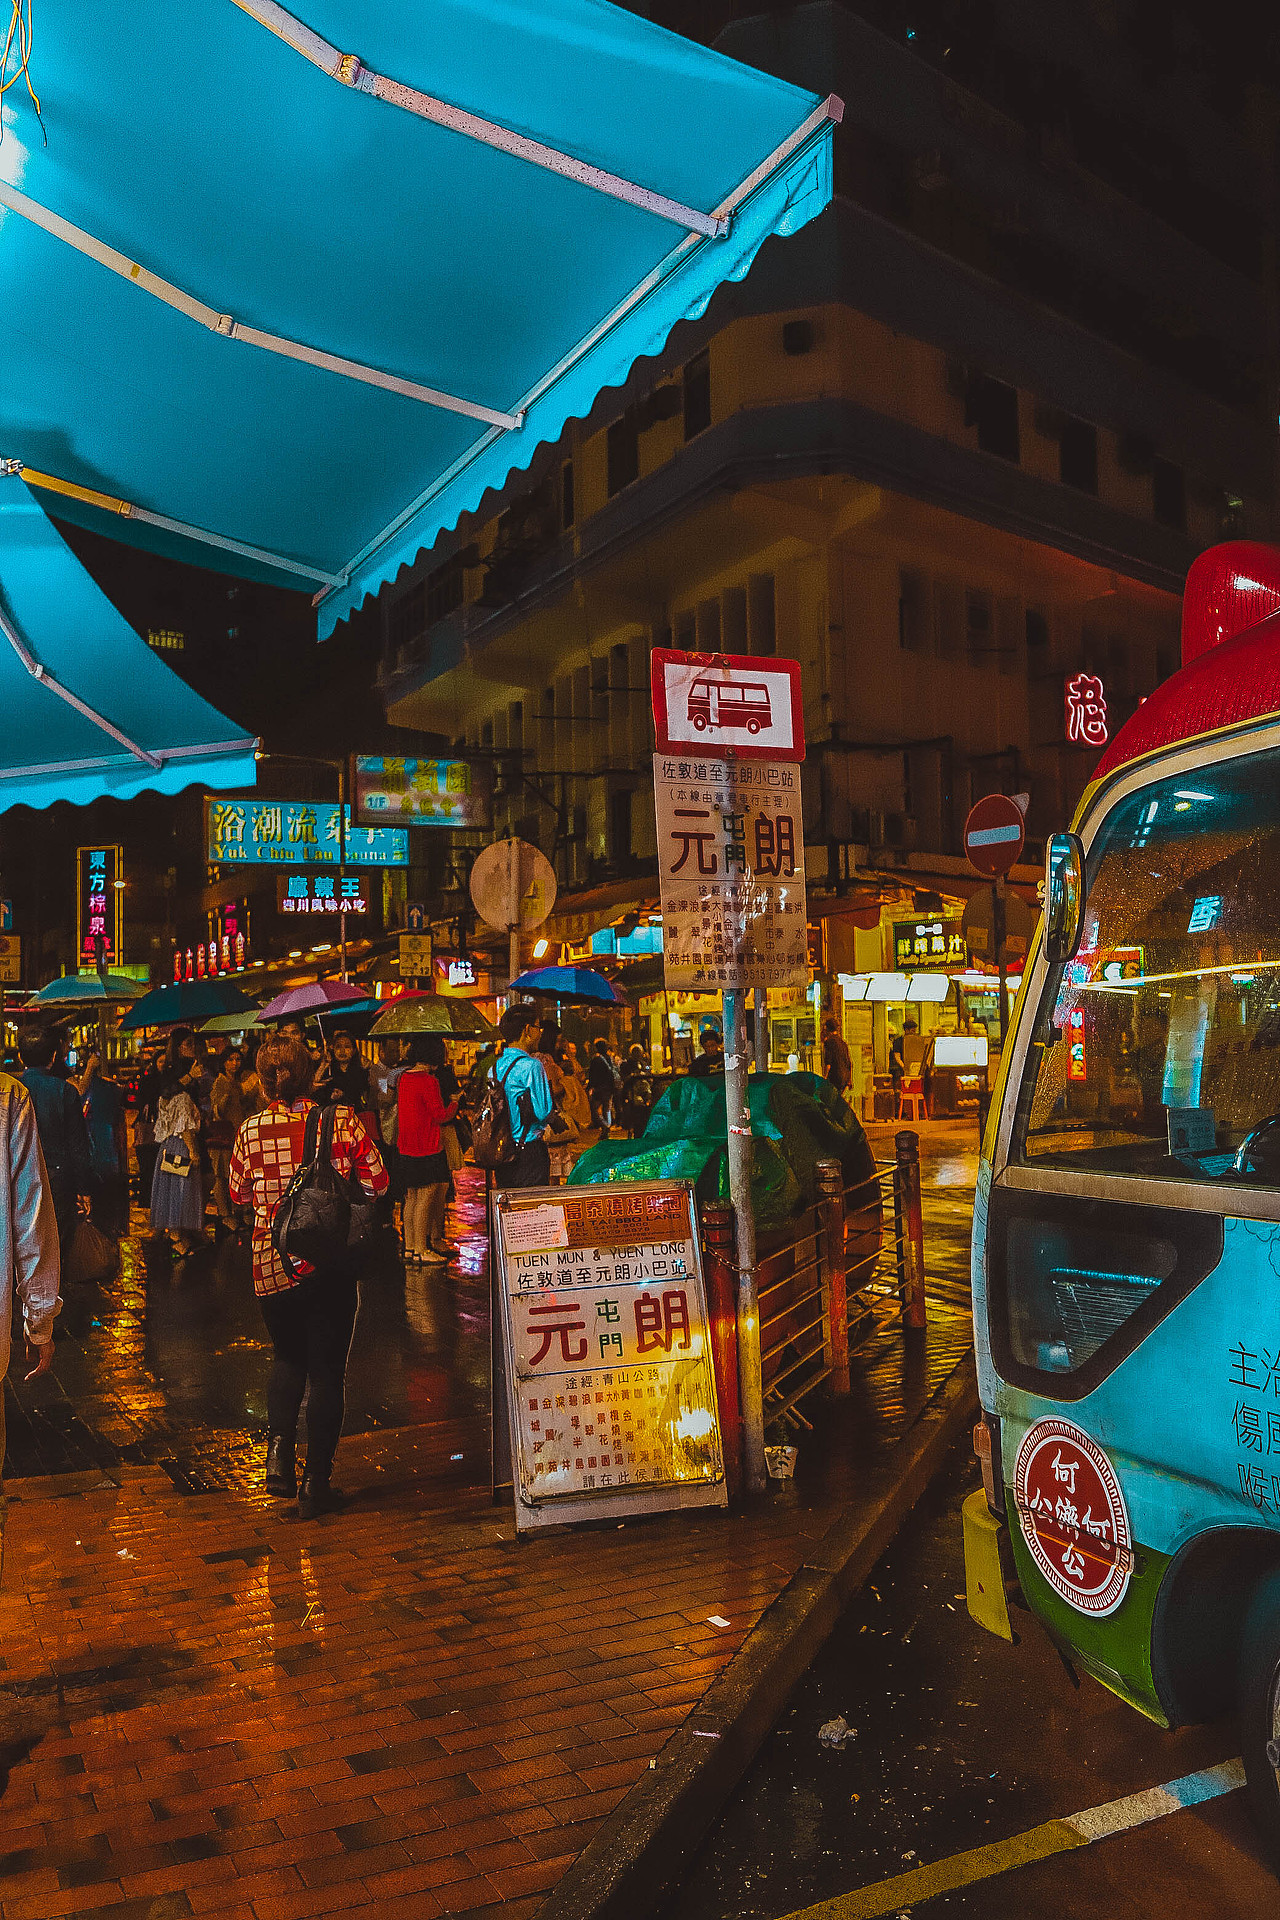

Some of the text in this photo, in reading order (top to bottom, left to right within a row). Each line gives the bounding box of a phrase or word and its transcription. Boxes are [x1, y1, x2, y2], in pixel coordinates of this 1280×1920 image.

[662, 761, 794, 787] 佐敦道至元朗小巴站
[214, 844, 247, 859] Yuk
[723, 811, 745, 874] 屯門
[646, 1213, 681, 1221] LAND
[514, 1243, 686, 1268] TUEN MUN & YUEN LONG
[517, 1258, 687, 1290] 佐敦道至元朗小巴站
[595, 1299, 623, 1358] 屯門
[582, 1466, 664, 1489] 請在此候車
